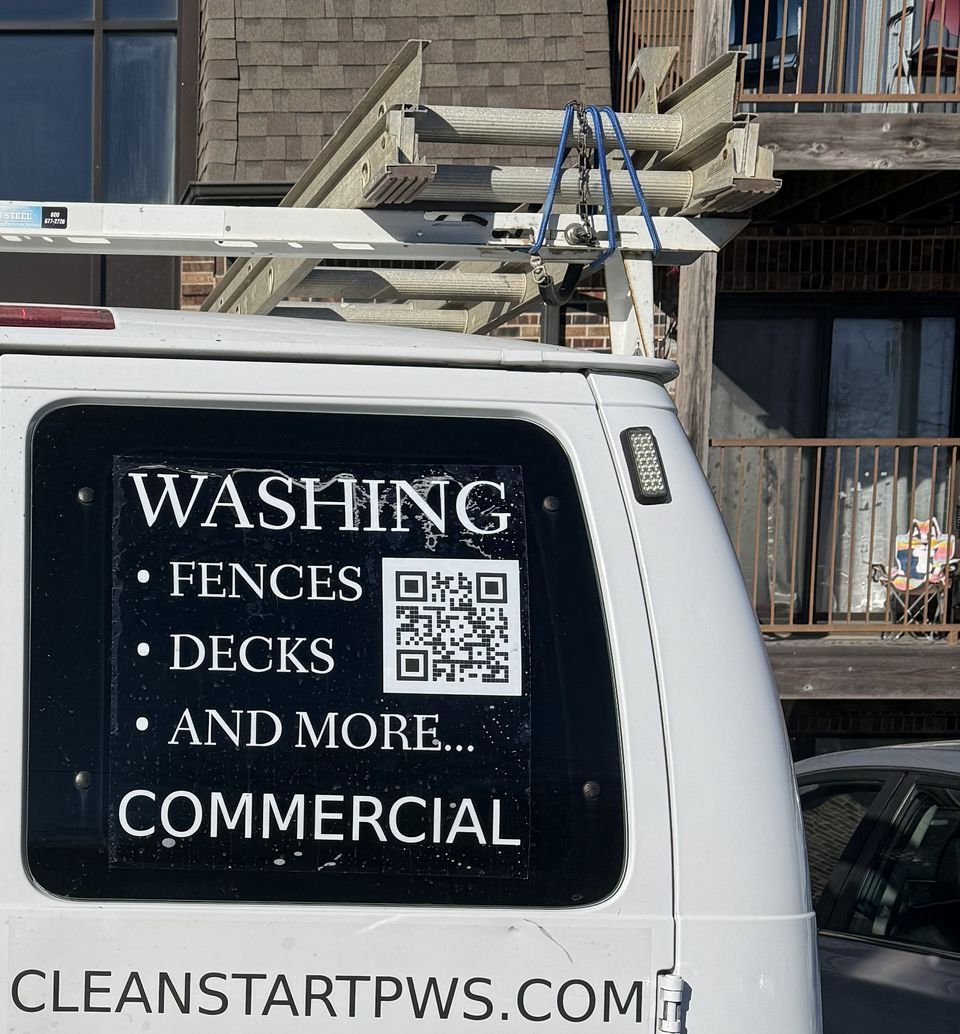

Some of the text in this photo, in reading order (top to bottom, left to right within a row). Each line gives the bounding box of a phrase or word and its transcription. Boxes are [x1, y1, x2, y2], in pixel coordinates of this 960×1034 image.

[128, 473, 511, 534] WASHING
[169, 561, 362, 601] FENCES
[169, 634, 335, 674] DECKS
[168, 708, 474, 752] AND MORE...
[118, 789, 521, 846] COMMERCIAL
[11, 969, 643, 1023] CLEANSTARTPWS.COM
